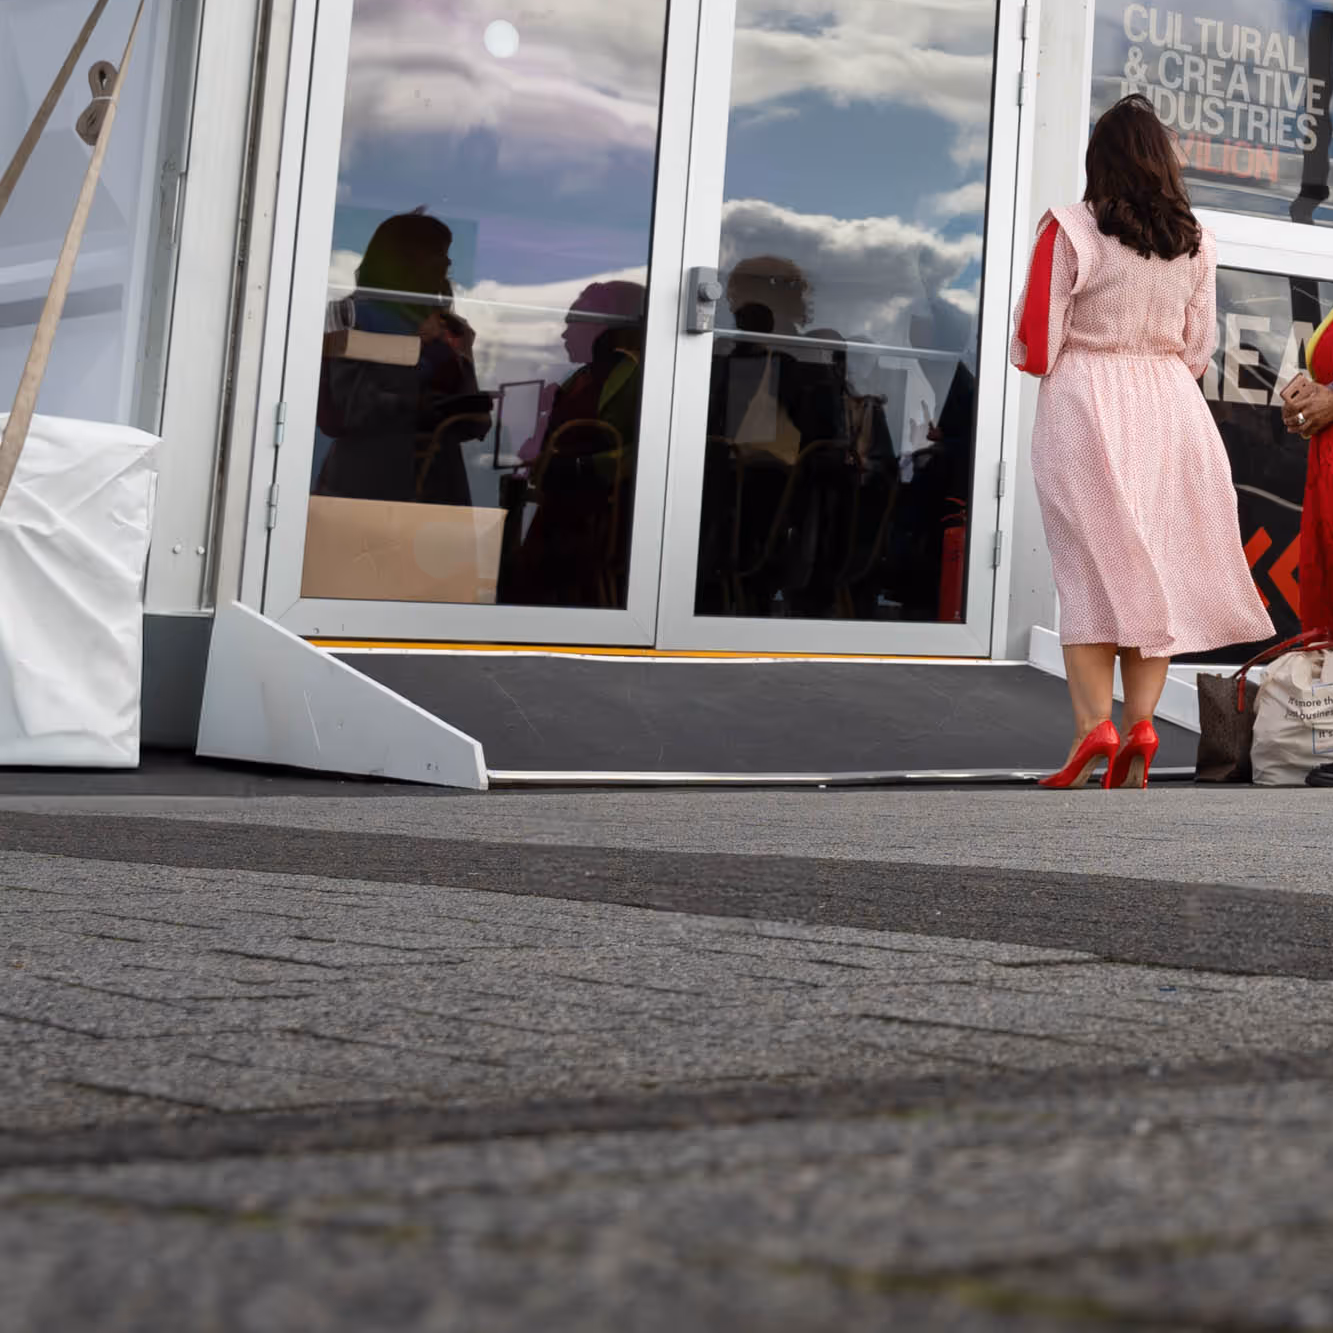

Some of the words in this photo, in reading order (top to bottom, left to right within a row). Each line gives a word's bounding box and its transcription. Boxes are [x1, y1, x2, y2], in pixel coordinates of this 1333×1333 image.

[1123, 3, 1305, 74] CULTURAL
[1124, 46, 1149, 83] &
[1158, 50, 1326, 116] CREATIVE
